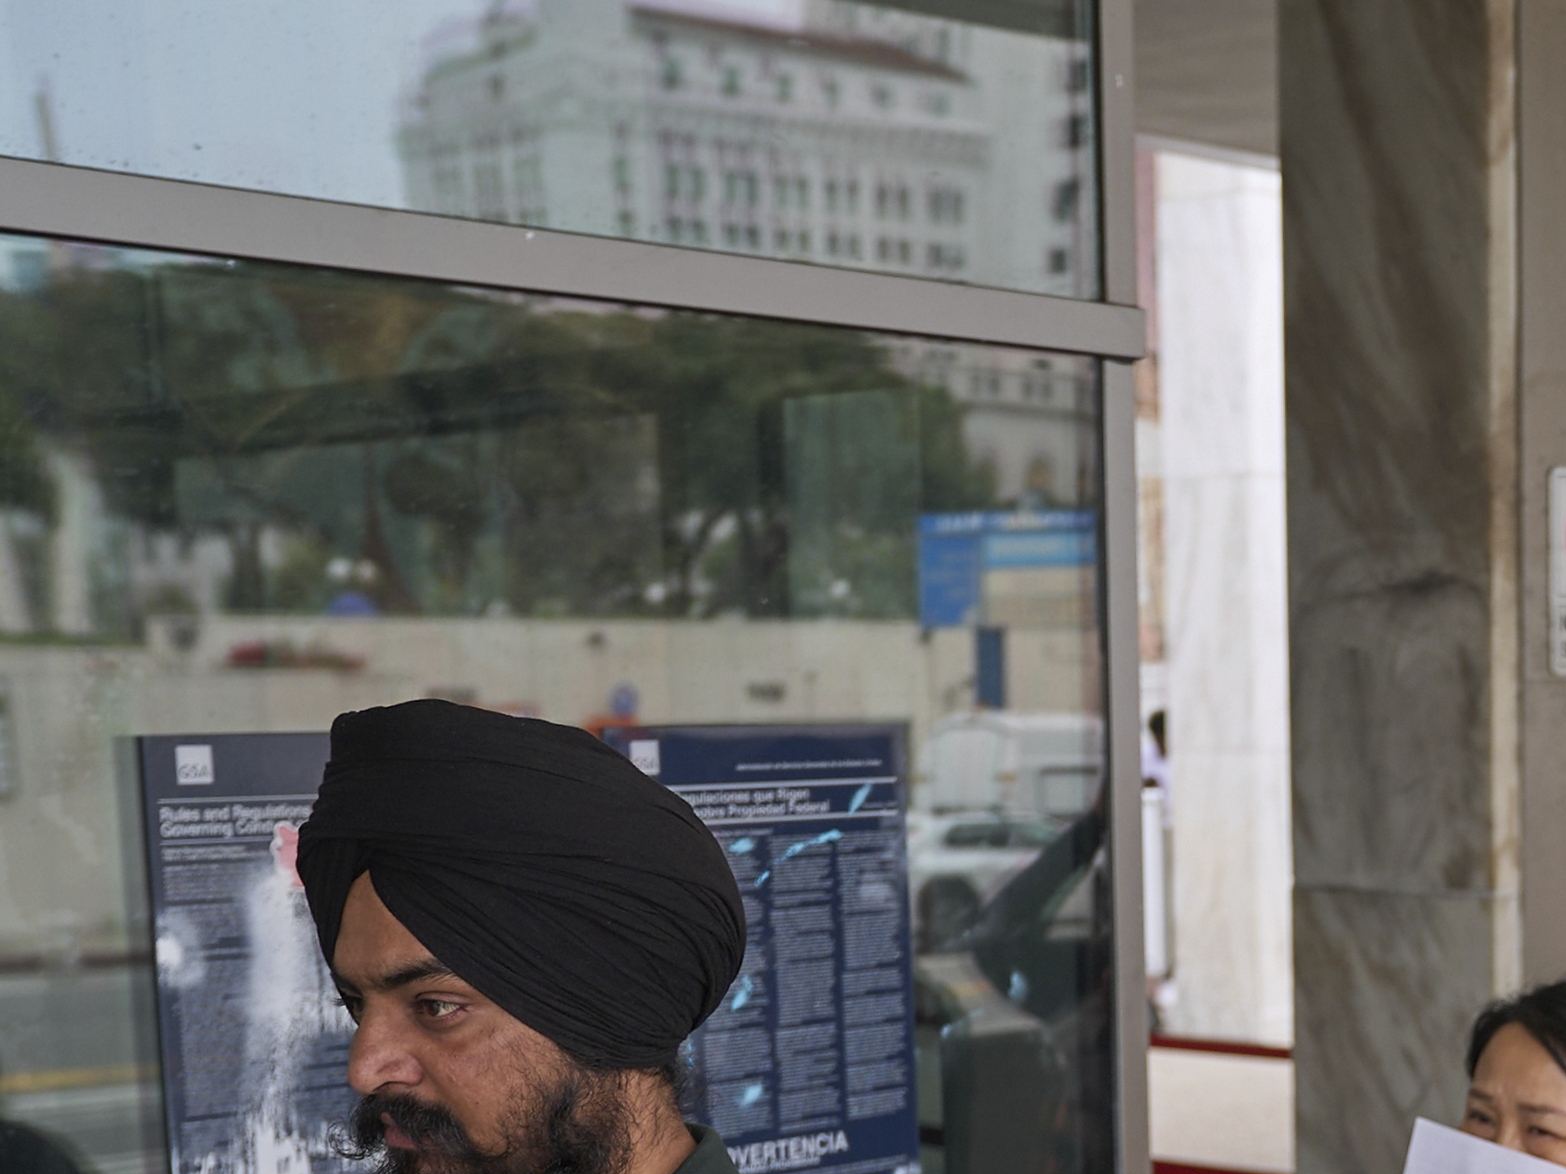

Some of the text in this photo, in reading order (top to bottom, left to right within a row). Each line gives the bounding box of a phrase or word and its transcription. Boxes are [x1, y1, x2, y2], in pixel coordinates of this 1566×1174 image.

[160, 807, 200, 822] Rules
[203, 805, 230, 821] and
[161, 821, 234, 838] Governing
